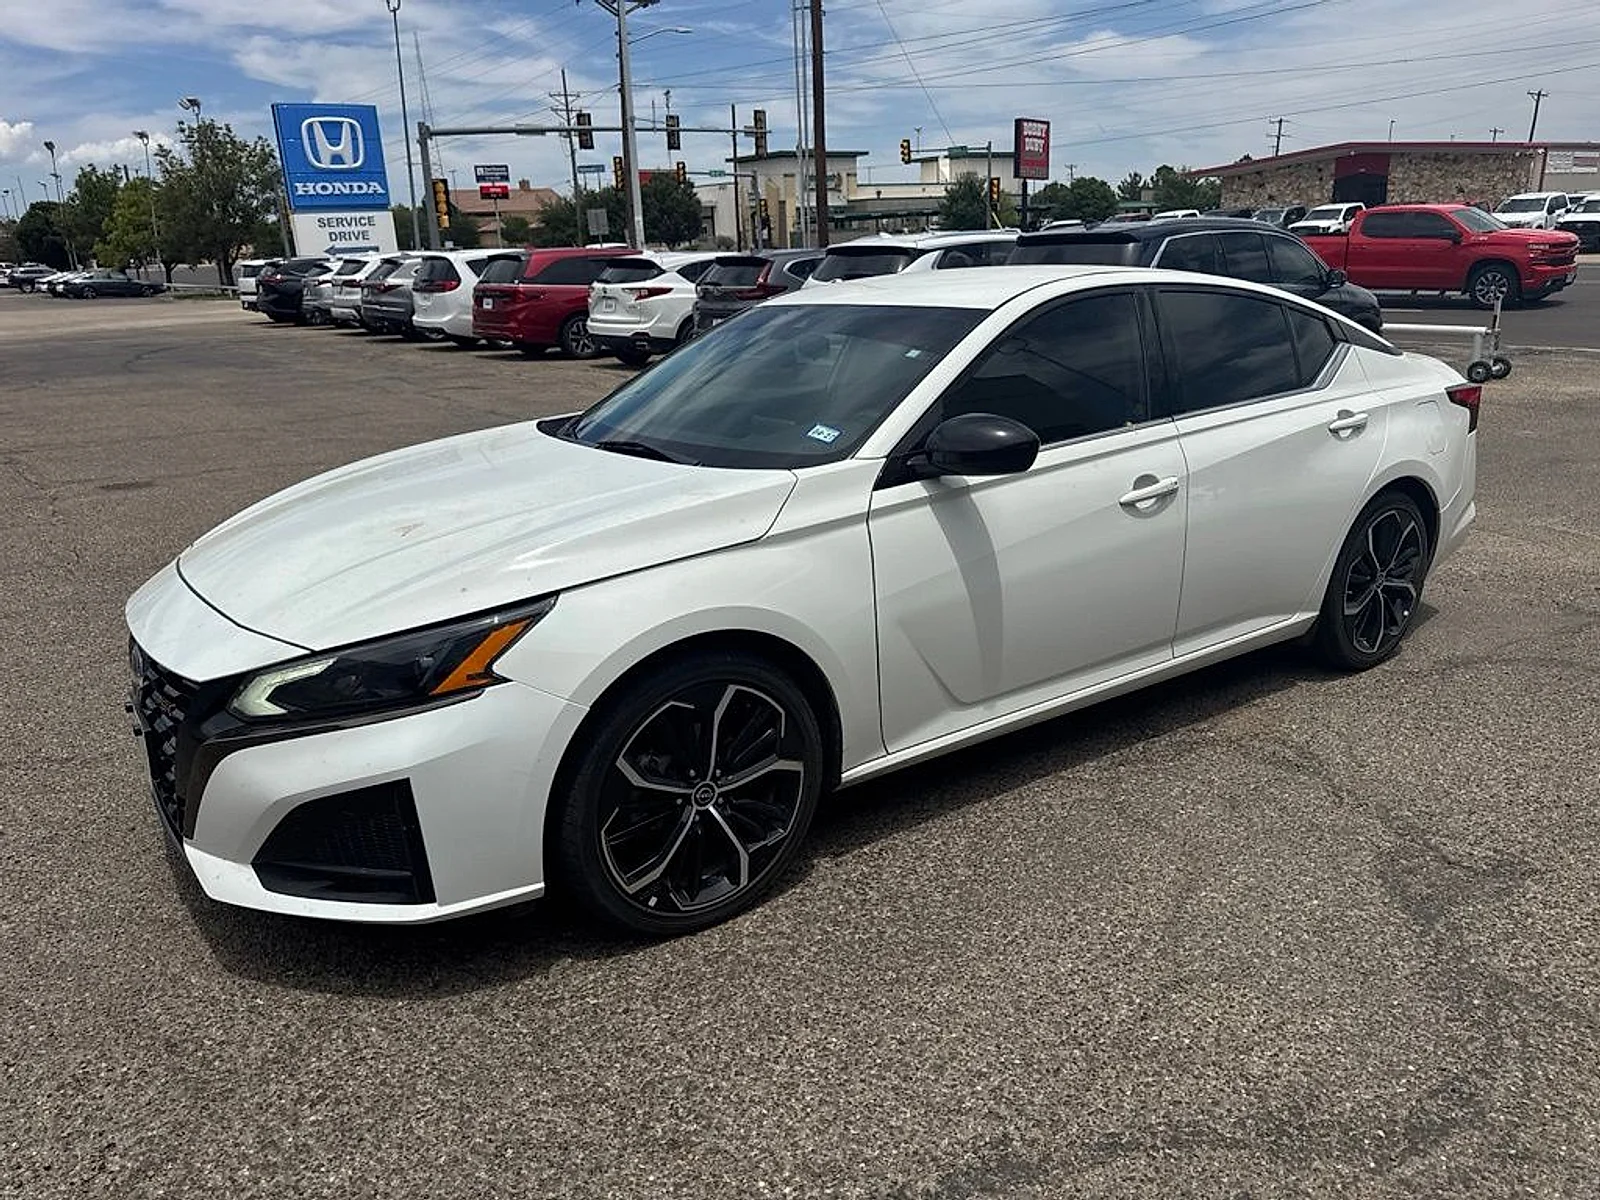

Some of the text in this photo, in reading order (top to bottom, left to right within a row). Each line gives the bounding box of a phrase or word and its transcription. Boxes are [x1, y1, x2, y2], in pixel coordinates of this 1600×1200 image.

[294, 182, 386, 196] HONDA
[317, 215, 376, 228] SERVICE
[328, 230, 370, 242] DRIVE
